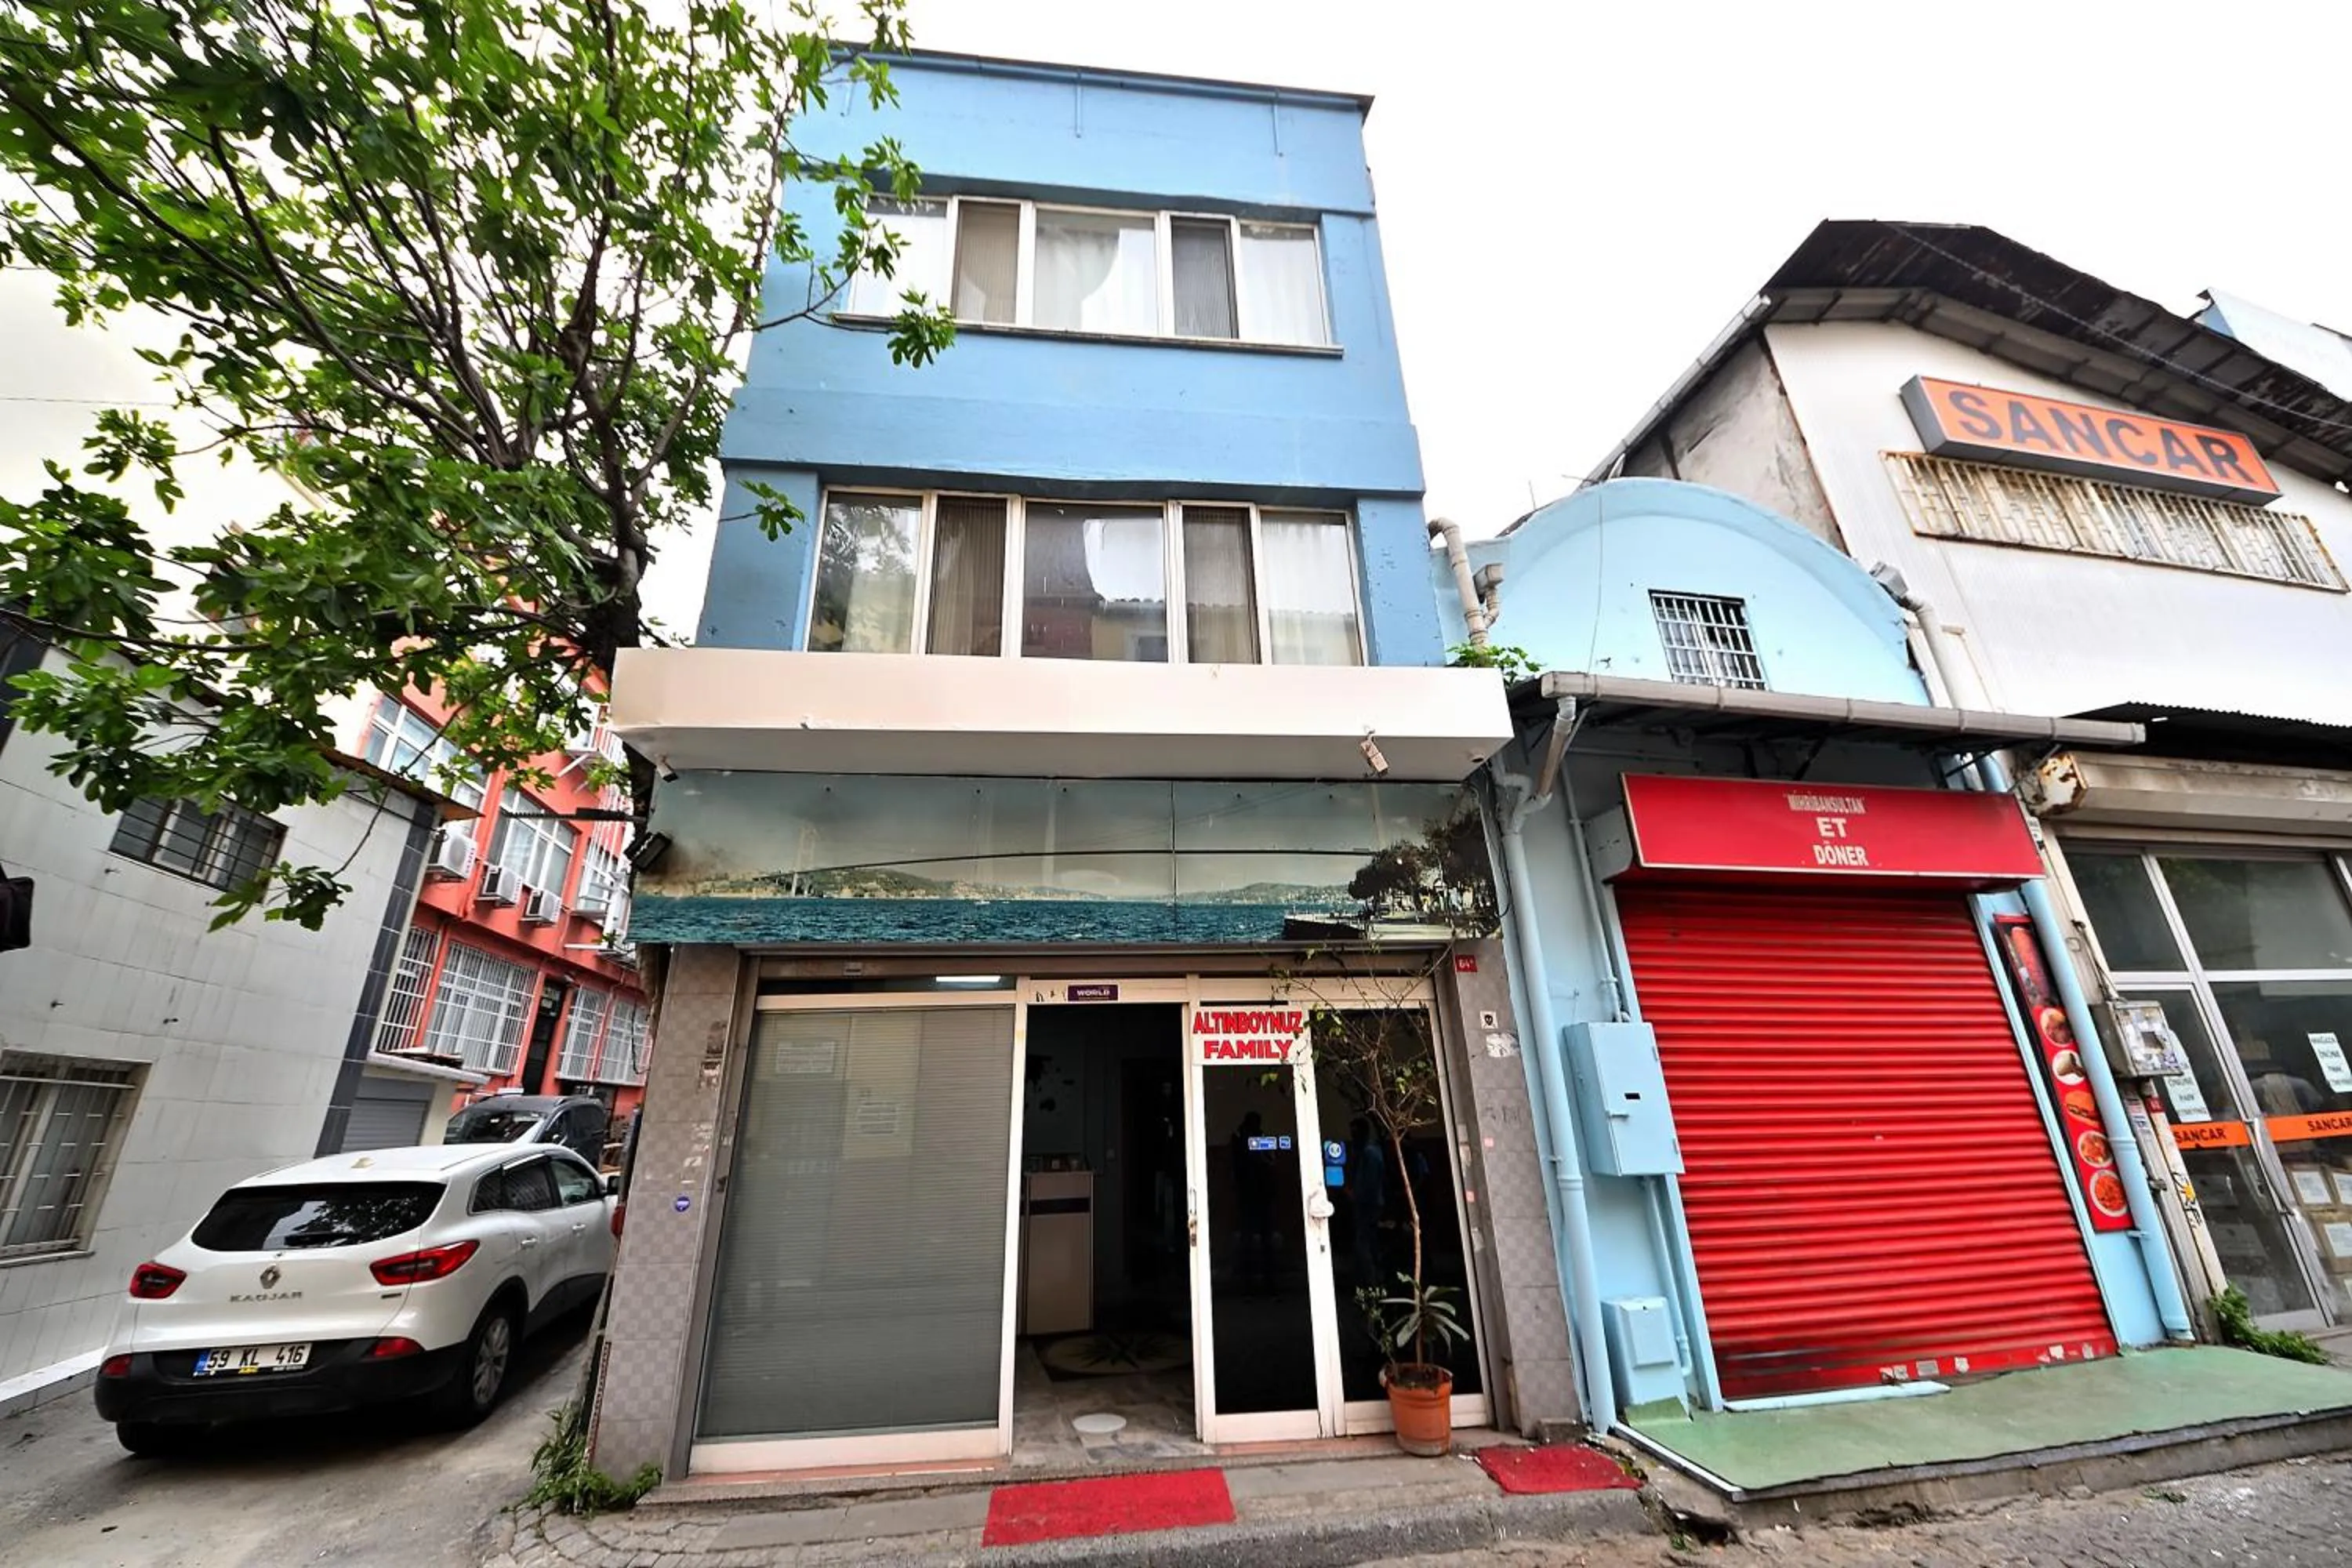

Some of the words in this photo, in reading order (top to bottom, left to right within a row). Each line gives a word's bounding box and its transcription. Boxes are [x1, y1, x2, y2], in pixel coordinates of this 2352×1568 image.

[1949, 390, 2257, 485] SANCAR
[1816, 817, 1847, 838] ET
[1813, 840, 1870, 866] DÖNER
[1192, 1011, 1304, 1034] ALTINBOYNUZ
[1203, 1039, 1294, 1060] FAMILY
[2175, 1127, 2227, 1142] SANCAR
[2307, 1116, 2352, 1132] SANCAR
[207, 1349, 231, 1369] 59
[238, 1348, 260, 1366] KL
[275, 1345, 305, 1364] 416
